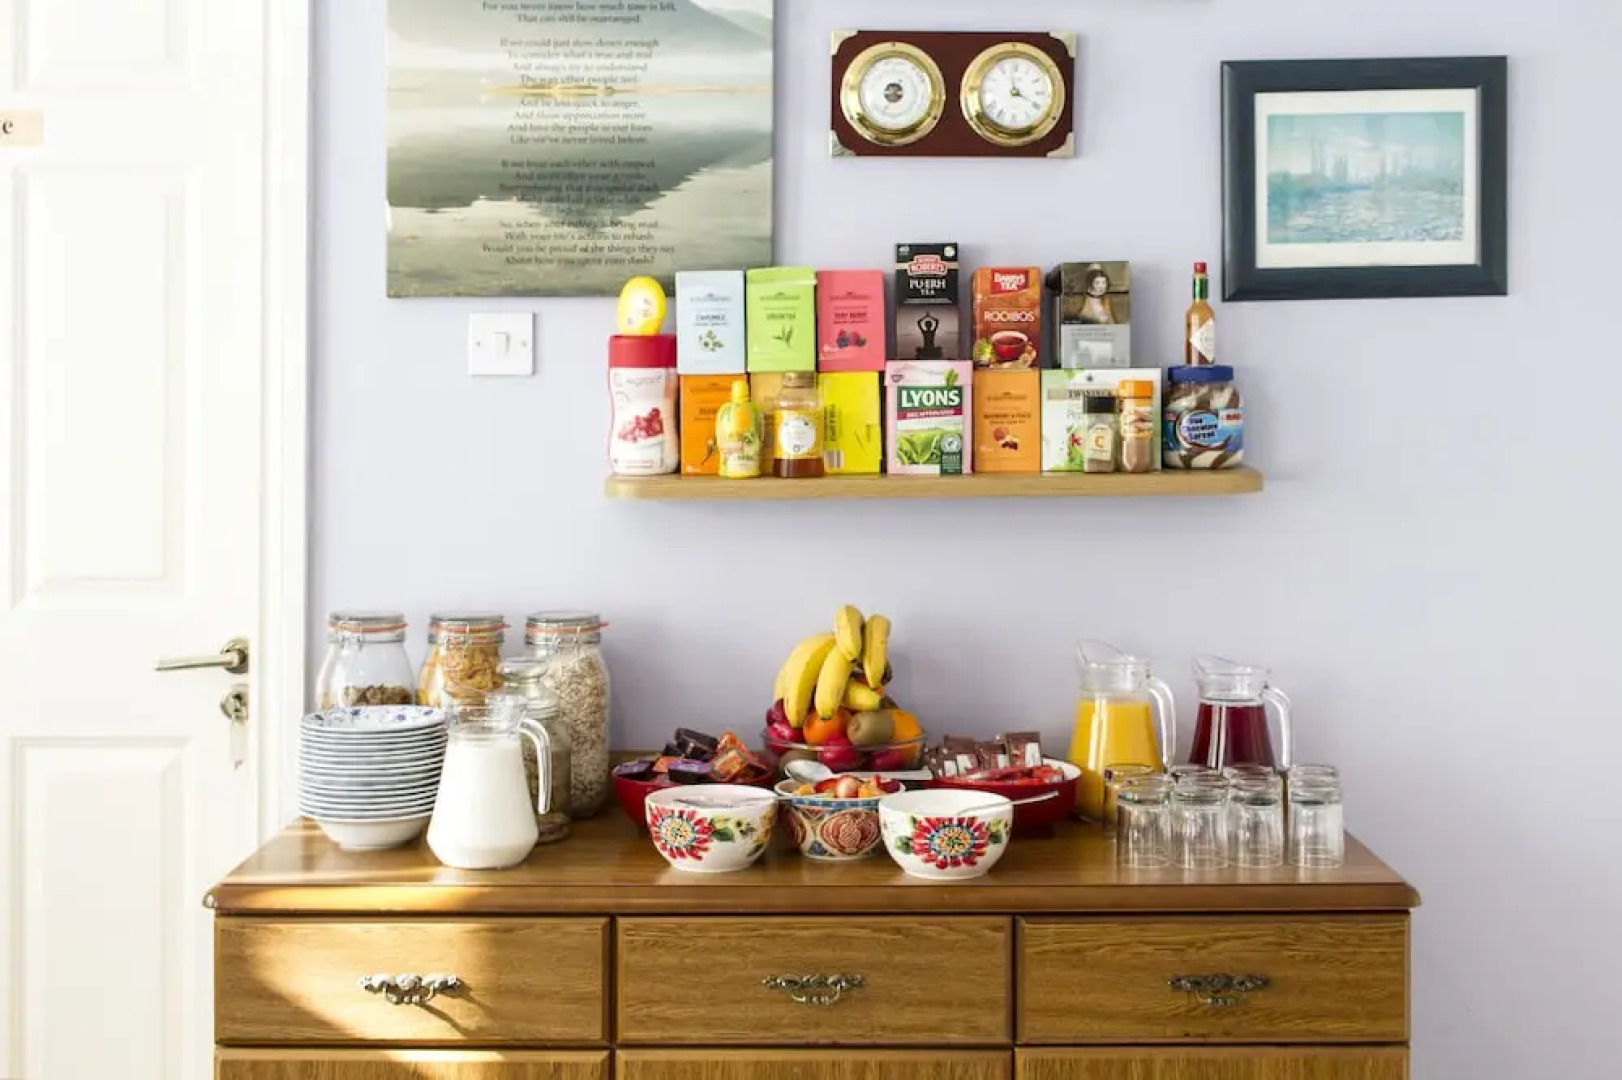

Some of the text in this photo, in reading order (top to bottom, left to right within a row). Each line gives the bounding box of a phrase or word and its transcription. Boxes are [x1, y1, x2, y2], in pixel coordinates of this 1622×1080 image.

[1001, 282, 1018, 291] TEA
[984, 311, 1036, 322] ROOIBOS
[901, 388, 960, 408] LYONS
